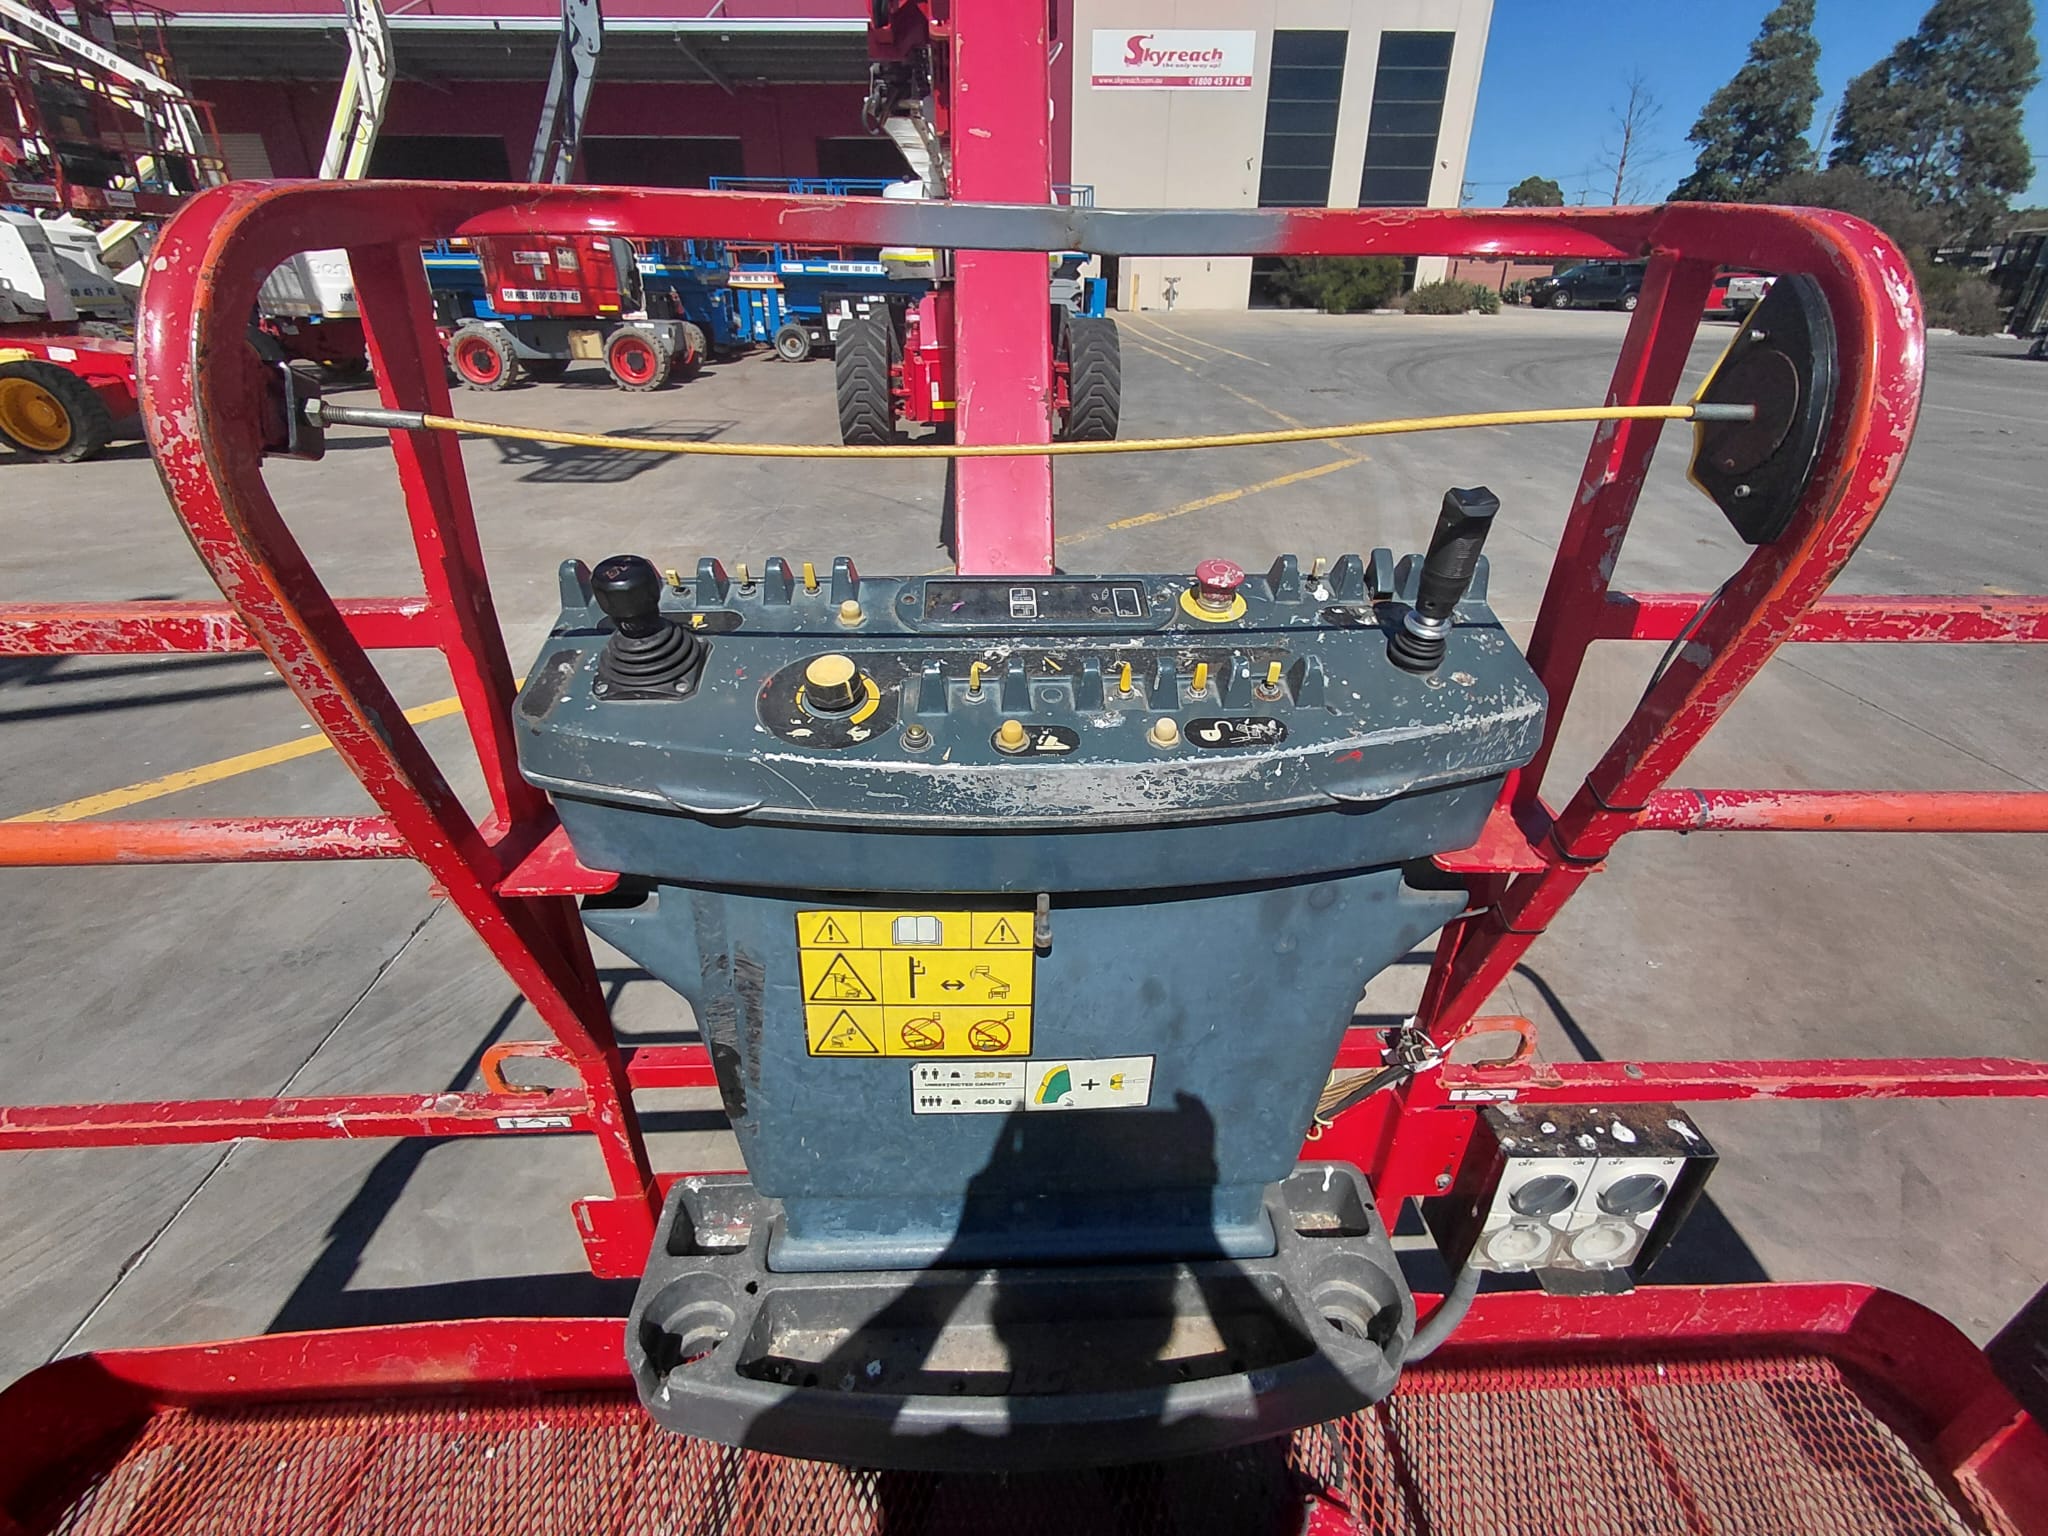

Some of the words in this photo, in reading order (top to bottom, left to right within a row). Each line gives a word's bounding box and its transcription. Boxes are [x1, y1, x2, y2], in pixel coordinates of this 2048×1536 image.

[1124, 34, 1223, 67] Skyreach
[1225, 77, 1234, 86] 71
[515, 291, 528, 300] HIRE
[532, 291, 546, 300] 1800
[997, 1071, 1013, 1079] kg
[998, 1098, 1012, 1106] kg
